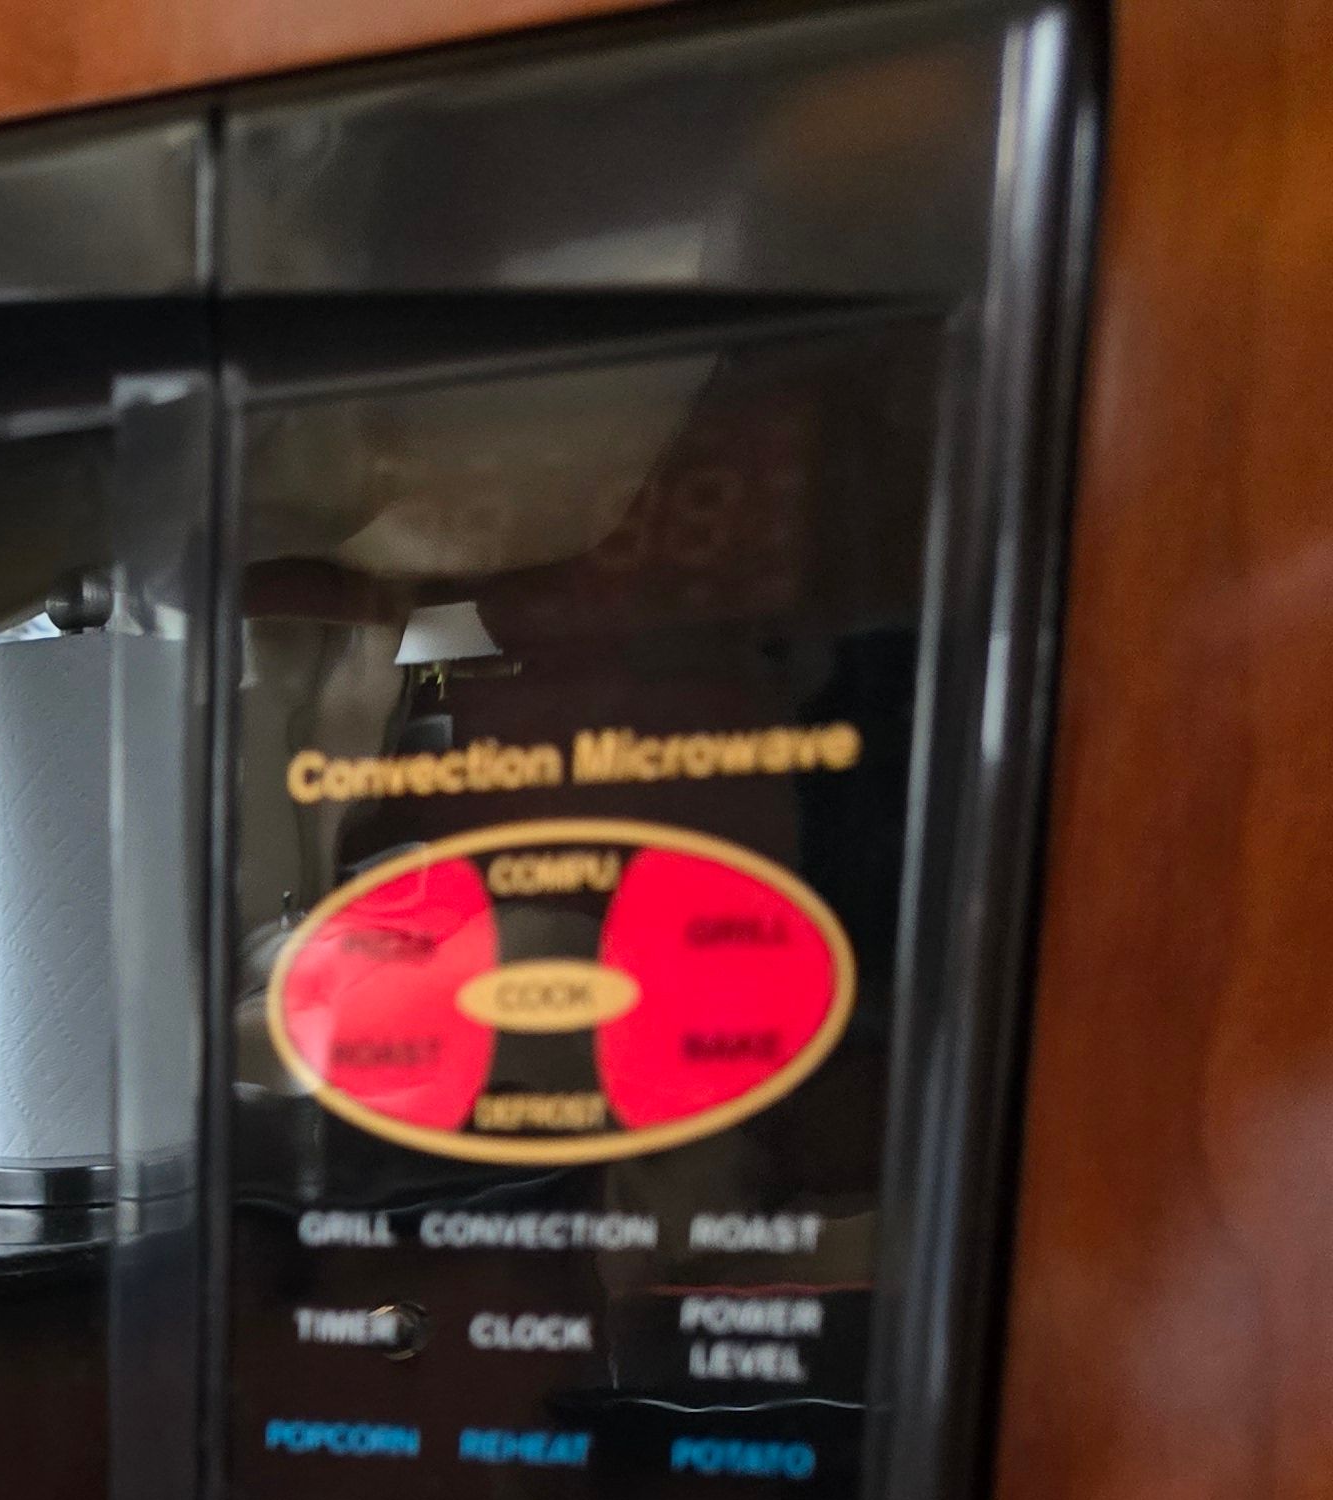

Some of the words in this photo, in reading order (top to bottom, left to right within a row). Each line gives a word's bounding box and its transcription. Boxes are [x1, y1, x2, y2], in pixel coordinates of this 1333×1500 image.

[286, 736, 564, 806] Convection
[570, 719, 863, 786] Microwave
[485, 851, 623, 896] COMPU
[297, 1210, 395, 1248] GRILL
[419, 1210, 660, 1251] CONVECTION
[687, 1212, 823, 1254] ROAST
[293, 1307, 401, 1345] TIMER
[468, 1311, 593, 1351] CLOCK
[679, 1296, 823, 1339] POWER
[687, 1342, 806, 1384] LEVEL
[264, 1417, 422, 1457] POPCORN
[458, 1427, 591, 1467] REHEAT
[669, 1435, 817, 1481] POTATO
